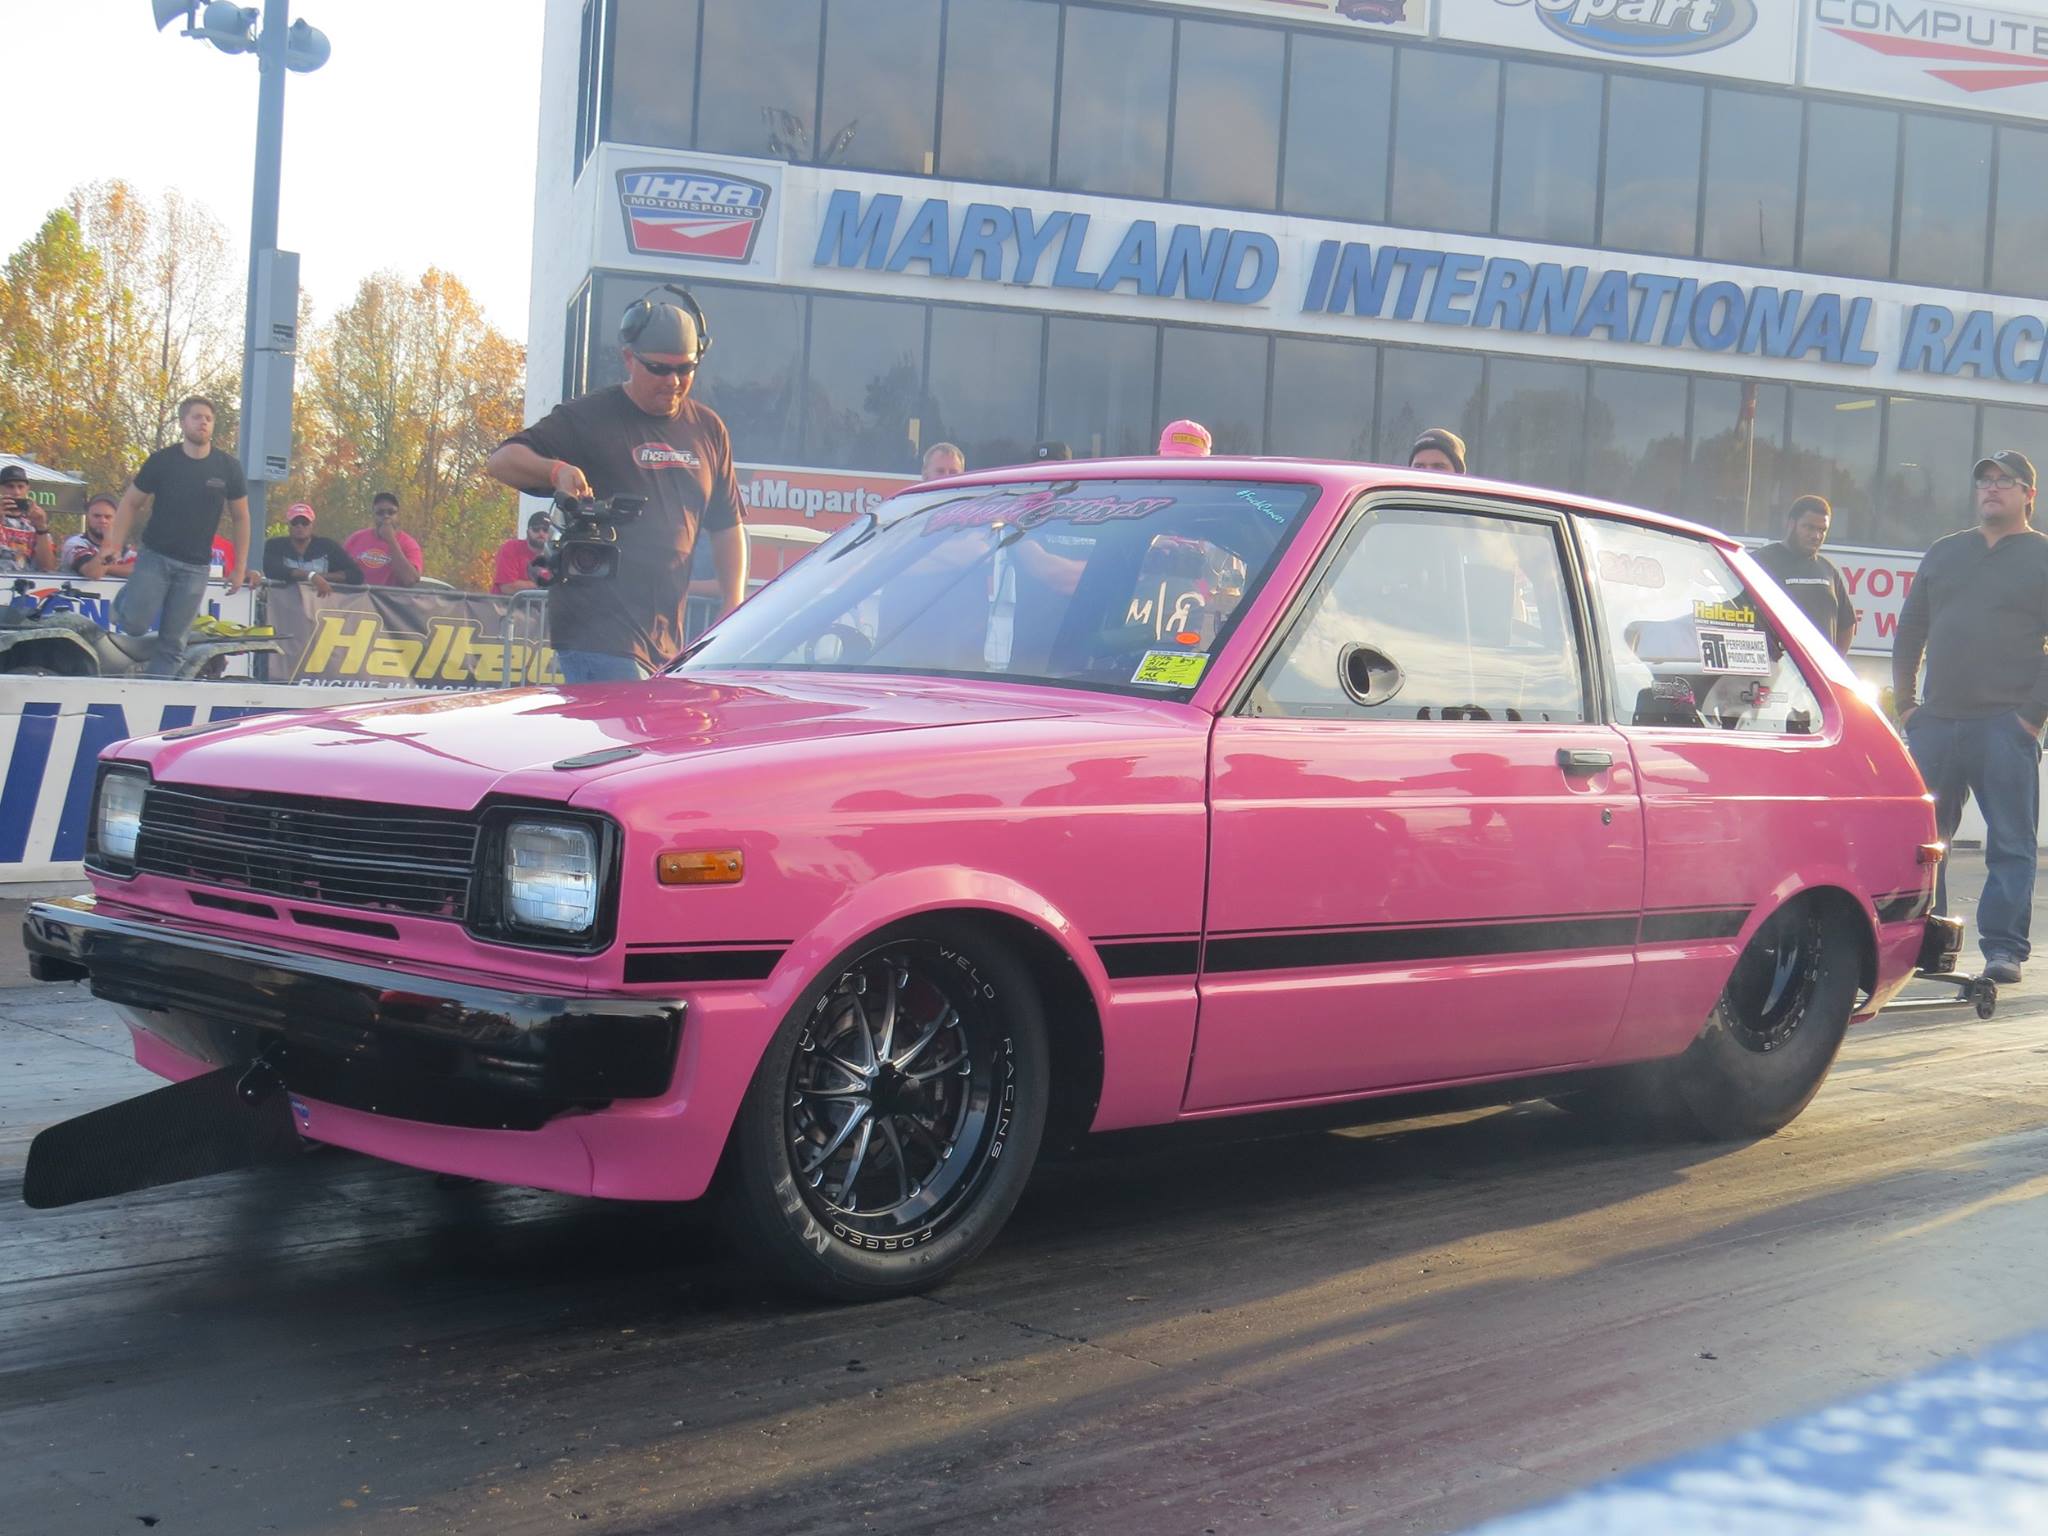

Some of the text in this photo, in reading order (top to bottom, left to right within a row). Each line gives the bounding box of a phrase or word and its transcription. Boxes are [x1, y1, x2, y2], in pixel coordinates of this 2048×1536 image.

[1492, 0, 1719, 33] part
[630, 196, 754, 217] MOTORSPORTS
[633, 175, 754, 207] IHRA
[813, 188, 2048, 386] MARYLAND INTERNATIONAL RAC
[1694, 599, 1755, 624] Haltech
[939, 945, 996, 999] WELD
[991, 1037, 1015, 1159] RACING
[833, 1223, 933, 1250] FORGED
